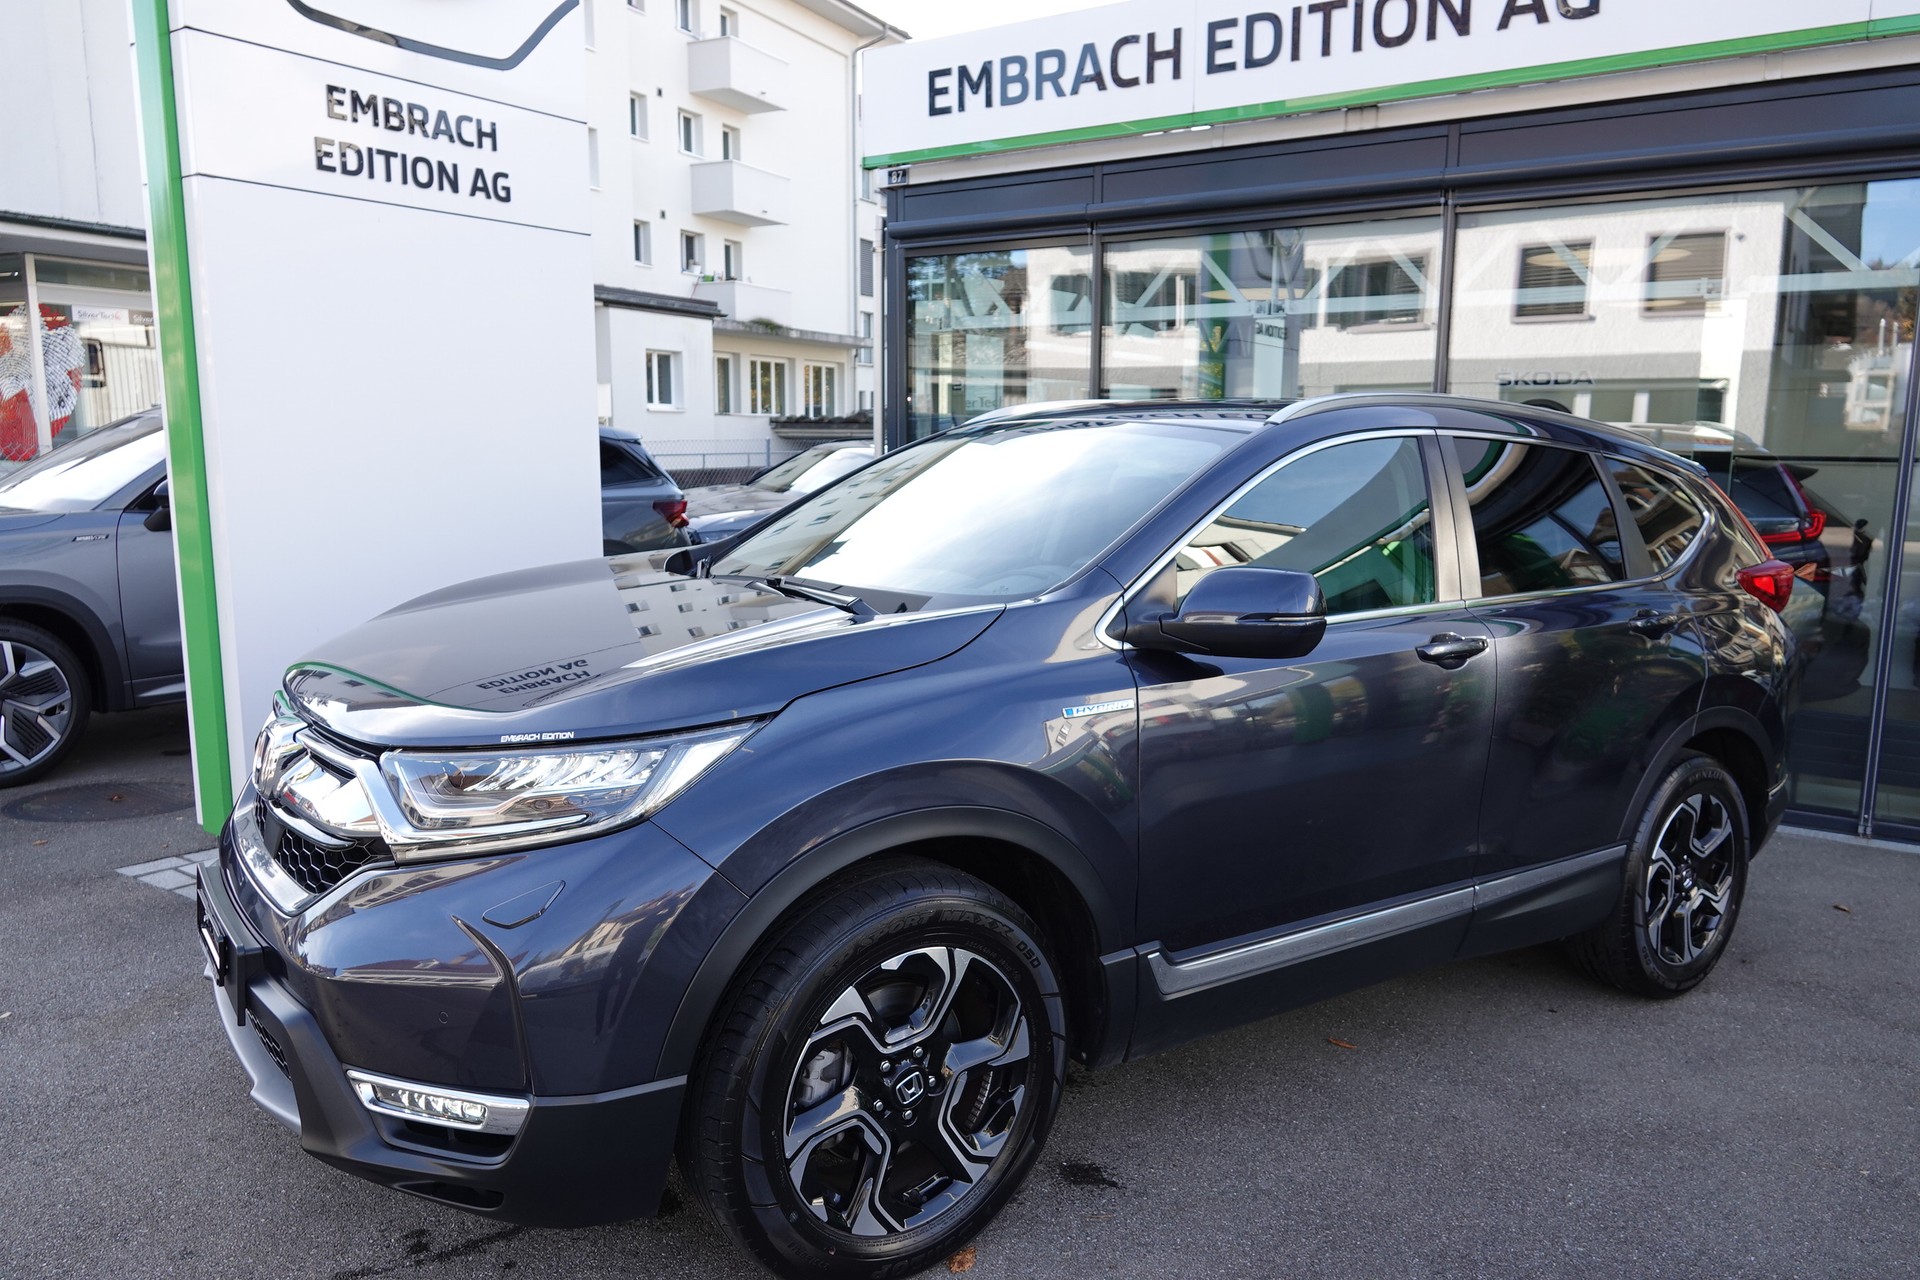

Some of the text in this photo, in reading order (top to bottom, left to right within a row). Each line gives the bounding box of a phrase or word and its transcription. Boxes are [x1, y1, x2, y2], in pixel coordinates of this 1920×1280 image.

[928, 27, 1182, 117] EMBRACH
[1206, 0, 1471, 75] EDITION
[326, 84, 497, 152] EMBRACH
[314, 136, 511, 203] EDITION AG
[891, 170, 904, 184] 87
[501, 731, 575, 743] EMBRACH EDITION
